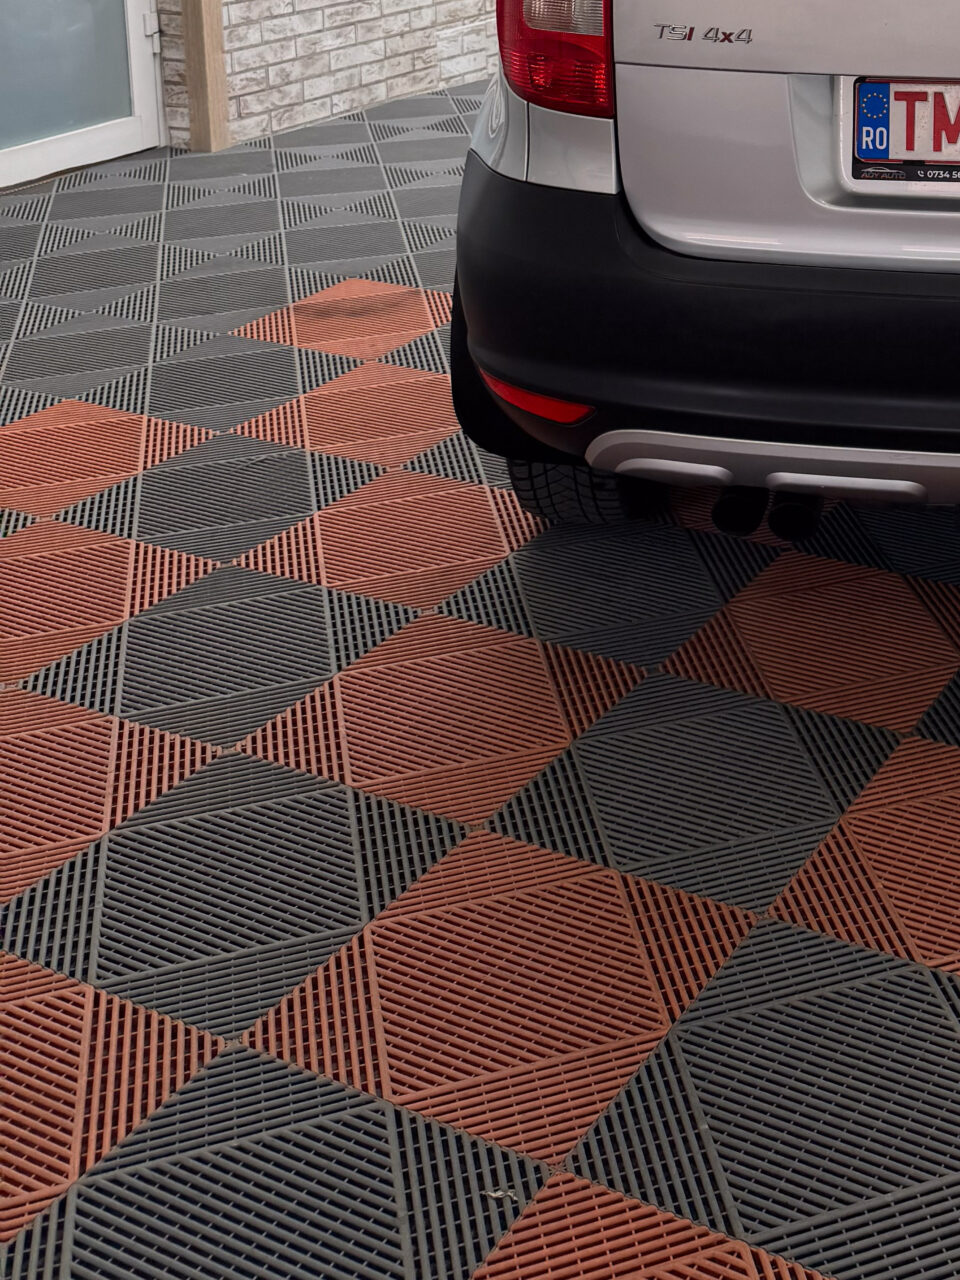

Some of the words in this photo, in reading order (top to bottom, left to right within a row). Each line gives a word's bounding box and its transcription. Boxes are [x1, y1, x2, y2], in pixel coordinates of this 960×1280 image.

[653, 23, 695, 41] TSI
[701, 27, 753, 44] 4x4
[861, 126, 887, 150] RO
[861, 170, 880, 179] ADY
[881, 171, 907, 180] AUTO
[926, 171, 950, 179] 0734
